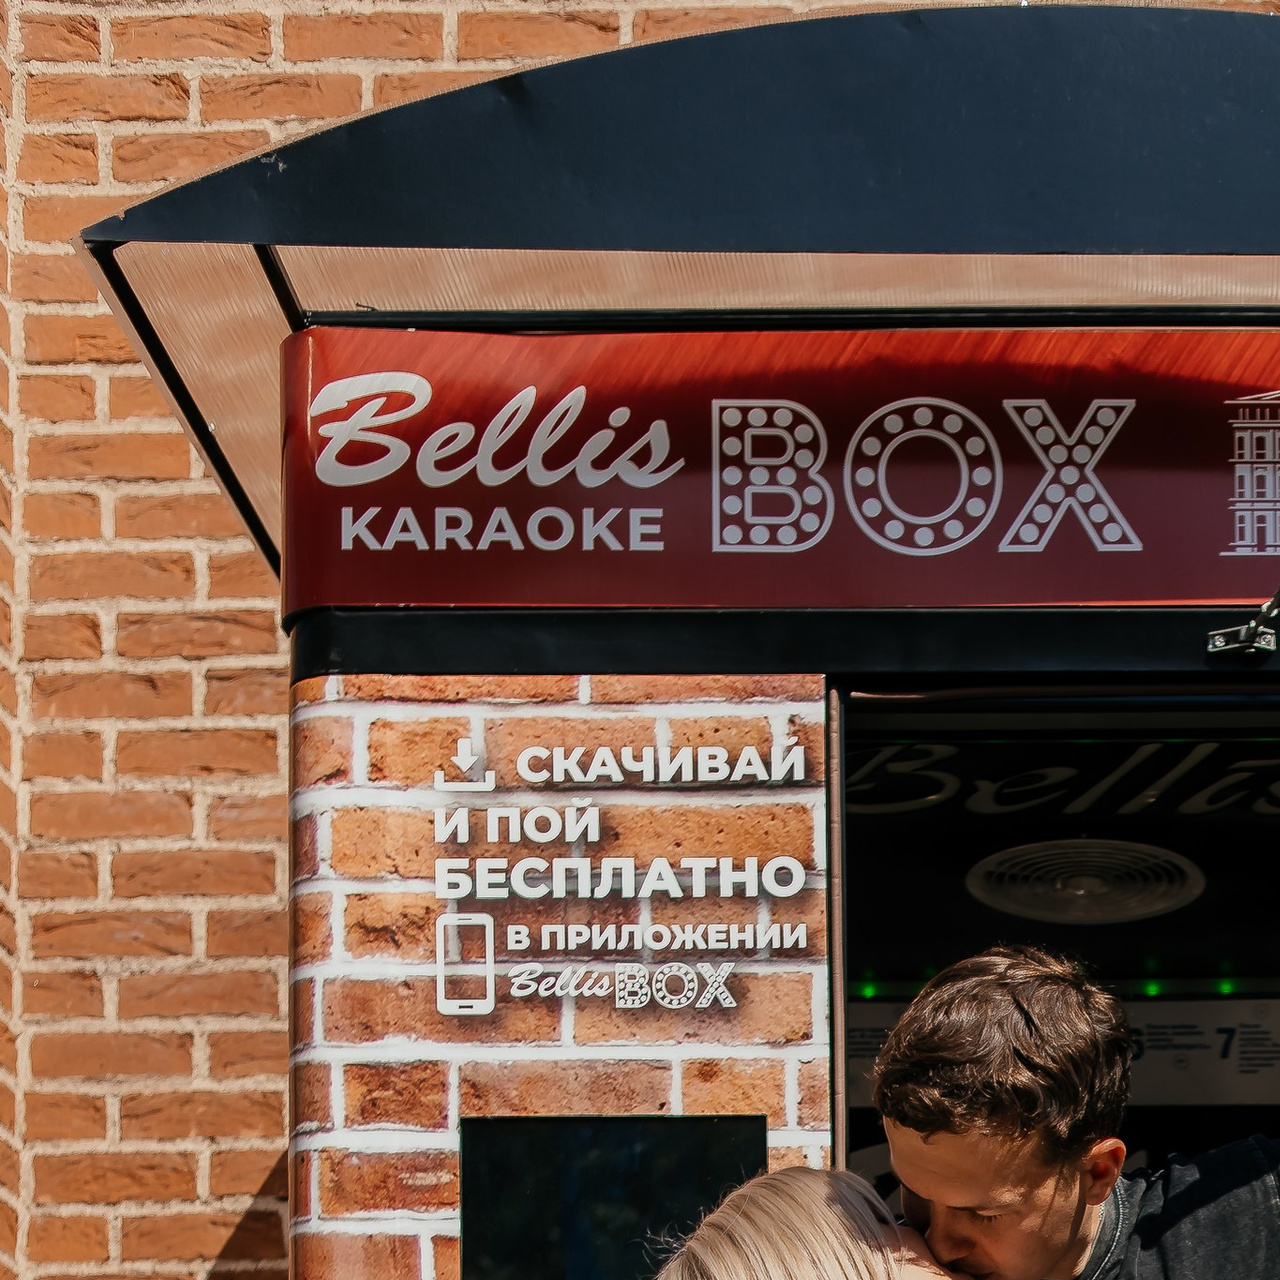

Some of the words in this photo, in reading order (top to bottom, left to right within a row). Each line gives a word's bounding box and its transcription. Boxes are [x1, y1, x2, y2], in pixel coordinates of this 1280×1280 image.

[310, 371, 685, 488] Bellis
[712, 397, 1143, 557] BOX
[340, 506, 666, 553] KARAOKE
[516, 737, 806, 783] СКАЧИВАЙ
[434, 807, 470, 844] И
[487, 798, 600, 844] ПОЙ
[434, 856, 806, 900] БЕСПЛАТНО
[506, 925, 531, 951] В
[541, 923, 808, 951] ПРИЛОЖЕНИИ
[1215, 1027, 1236, 1060] 7
